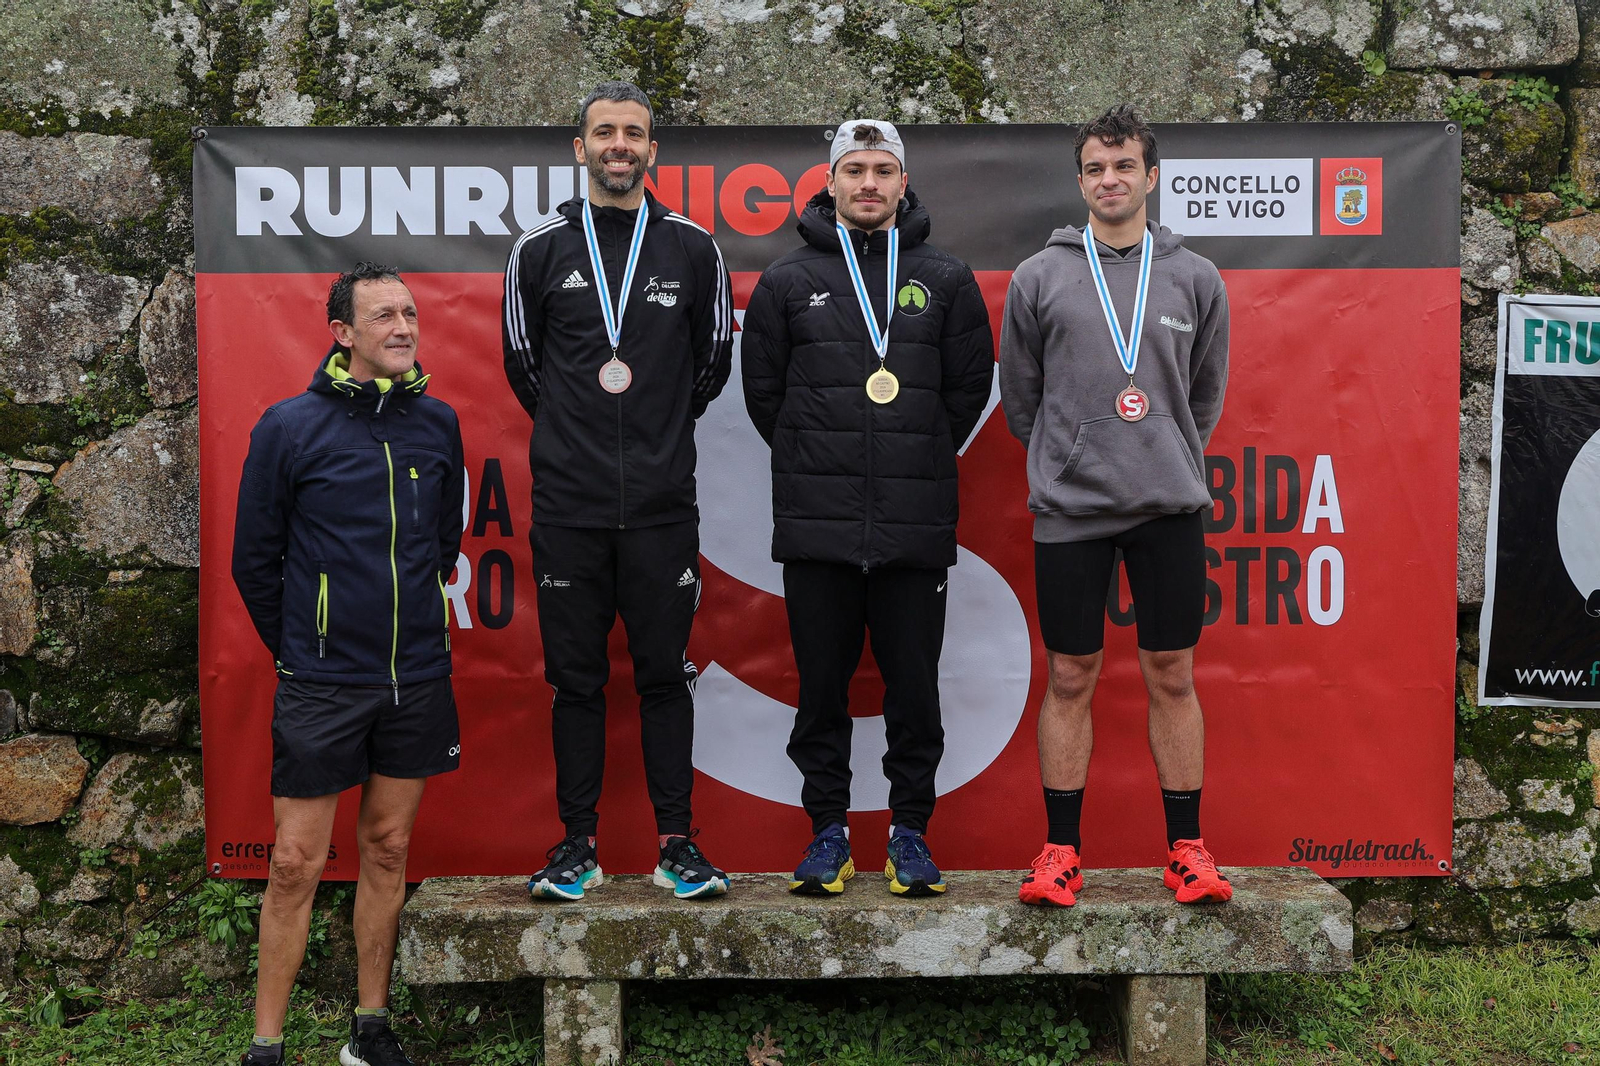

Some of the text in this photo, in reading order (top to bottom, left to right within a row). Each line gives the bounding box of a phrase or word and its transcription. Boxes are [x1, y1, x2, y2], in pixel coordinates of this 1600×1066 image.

[1171, 175, 1301, 195] CONCELLO
[1187, 200, 1285, 219] DE VIGO
[562, 281, 588, 289] adidas
